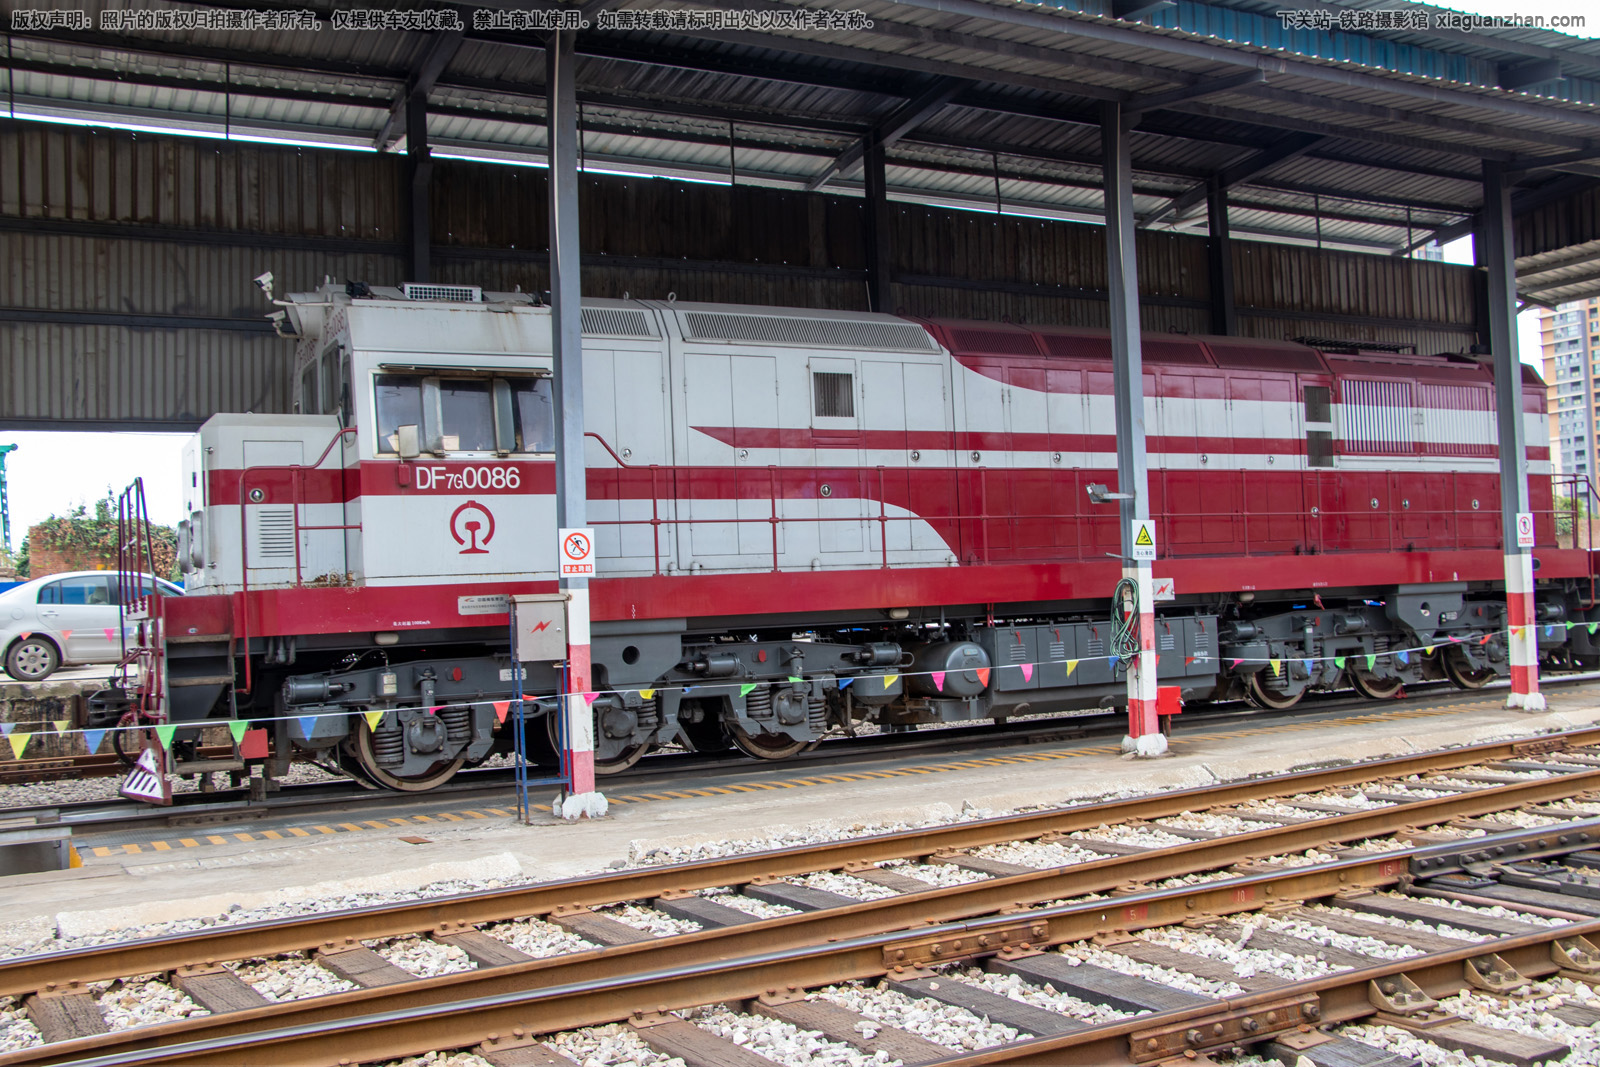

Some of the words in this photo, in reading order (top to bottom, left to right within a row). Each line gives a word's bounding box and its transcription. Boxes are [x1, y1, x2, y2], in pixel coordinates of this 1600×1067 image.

[415, 466, 521, 490] DF7G0086
[1384, 864, 1393, 876] 15
[1237, 890, 1246, 902] 10
[1130, 909, 1137, 921] 5
